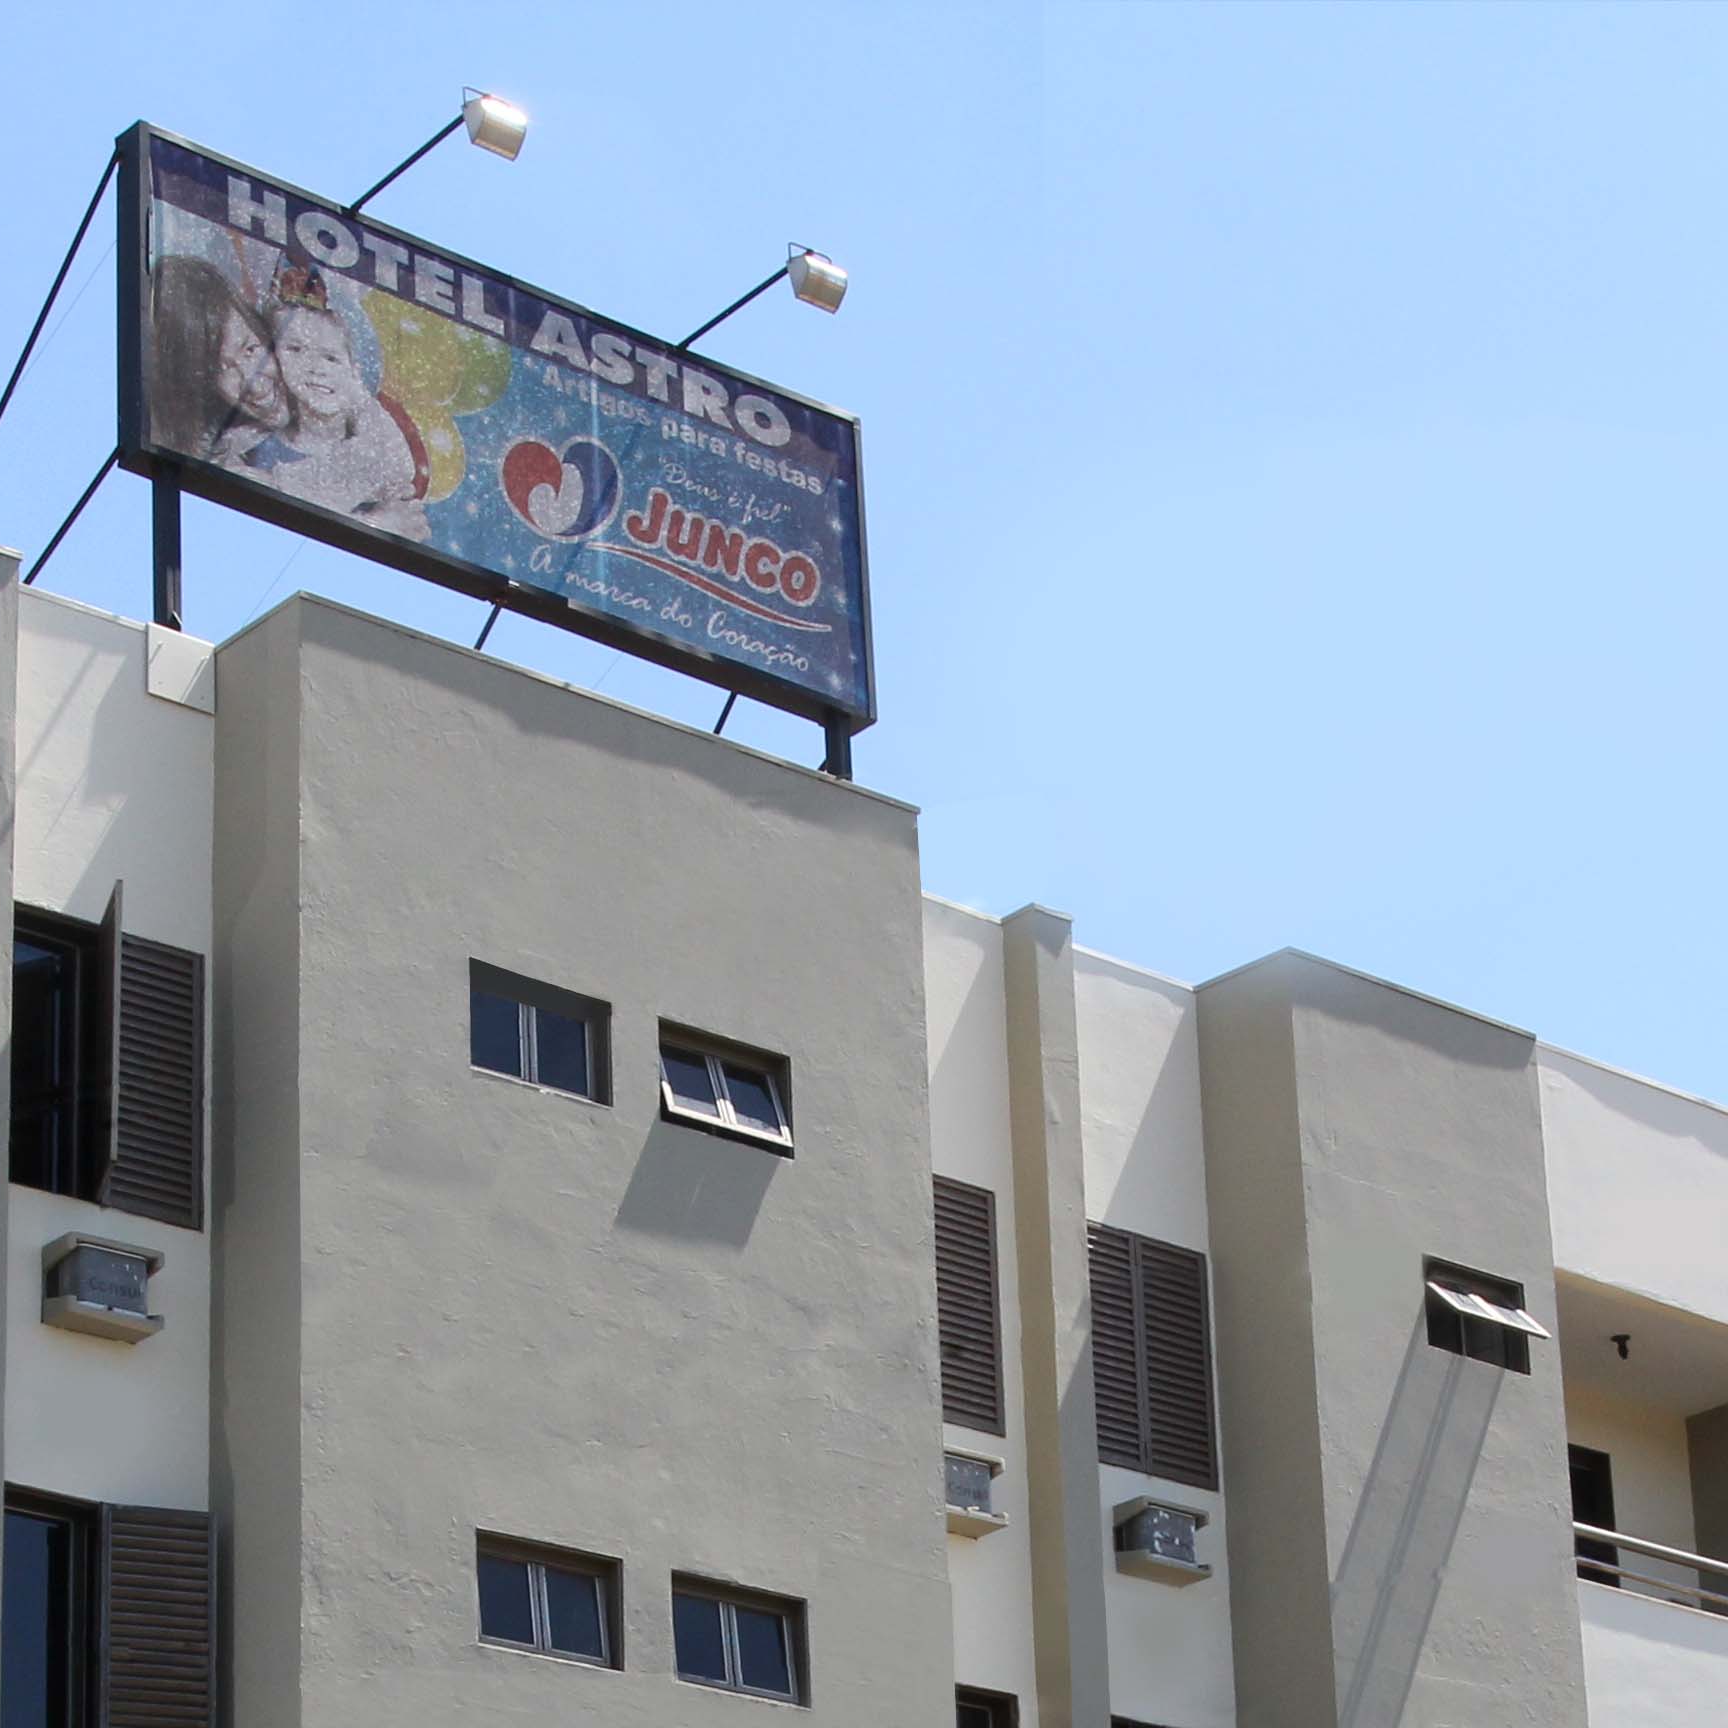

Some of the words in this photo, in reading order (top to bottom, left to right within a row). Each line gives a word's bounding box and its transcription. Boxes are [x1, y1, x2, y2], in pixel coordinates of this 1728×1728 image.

[227, 175, 506, 336] HOTEL
[529, 309, 791, 447] ASTRO
[661, 416, 726, 457] para
[733, 441, 824, 495] festas
[624, 488, 820, 606] JUNCO
[565, 571, 651, 610] marca
[661, 603, 692, 629] do
[707, 611, 808, 671] Coração
